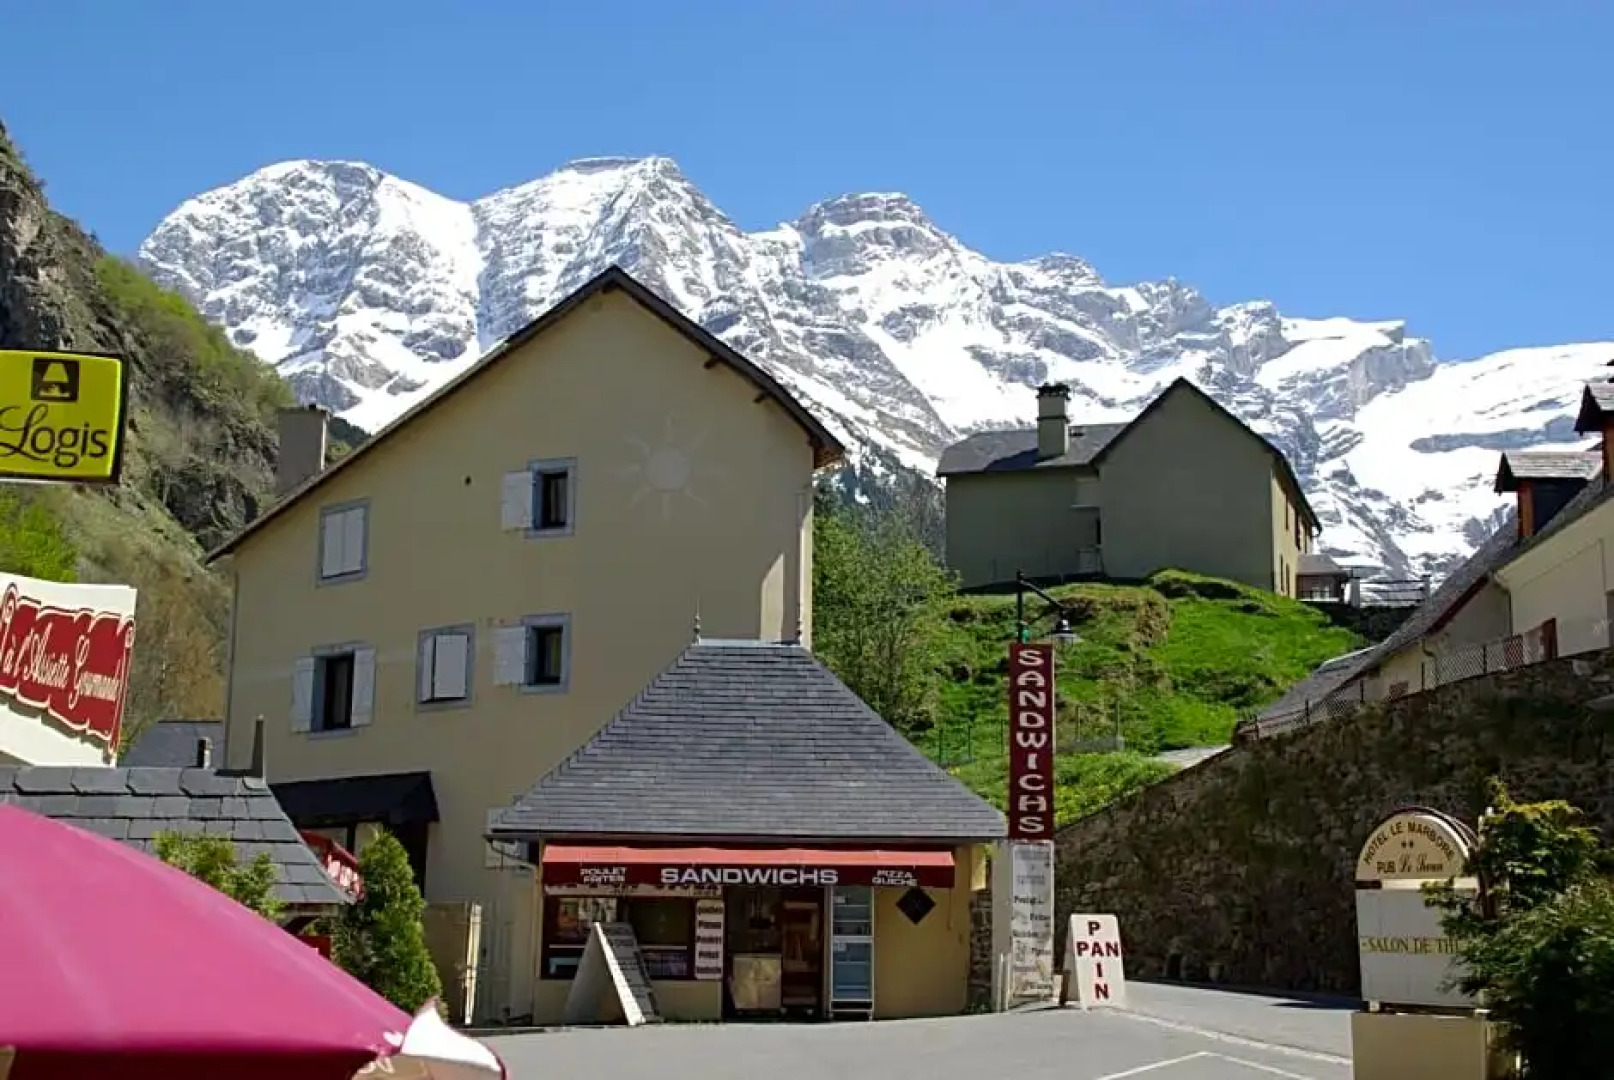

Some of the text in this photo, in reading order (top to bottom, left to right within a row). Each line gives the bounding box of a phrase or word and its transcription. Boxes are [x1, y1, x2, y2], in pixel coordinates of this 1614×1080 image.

[0, 403, 109, 468] Logis
[1016, 649, 1047, 834] SANDWICHS
[1363, 831, 1388, 866] HOTEL
[1390, 821, 1402, 836] LE
[660, 867, 839, 885] SANDWICHS
[876, 869, 913, 879] PIZZA
[1376, 861, 1397, 874] PUB
[871, 877, 918, 887] QUICHE
[1367, 936, 1409, 953] SALON
[1413, 935, 1431, 955] DE
